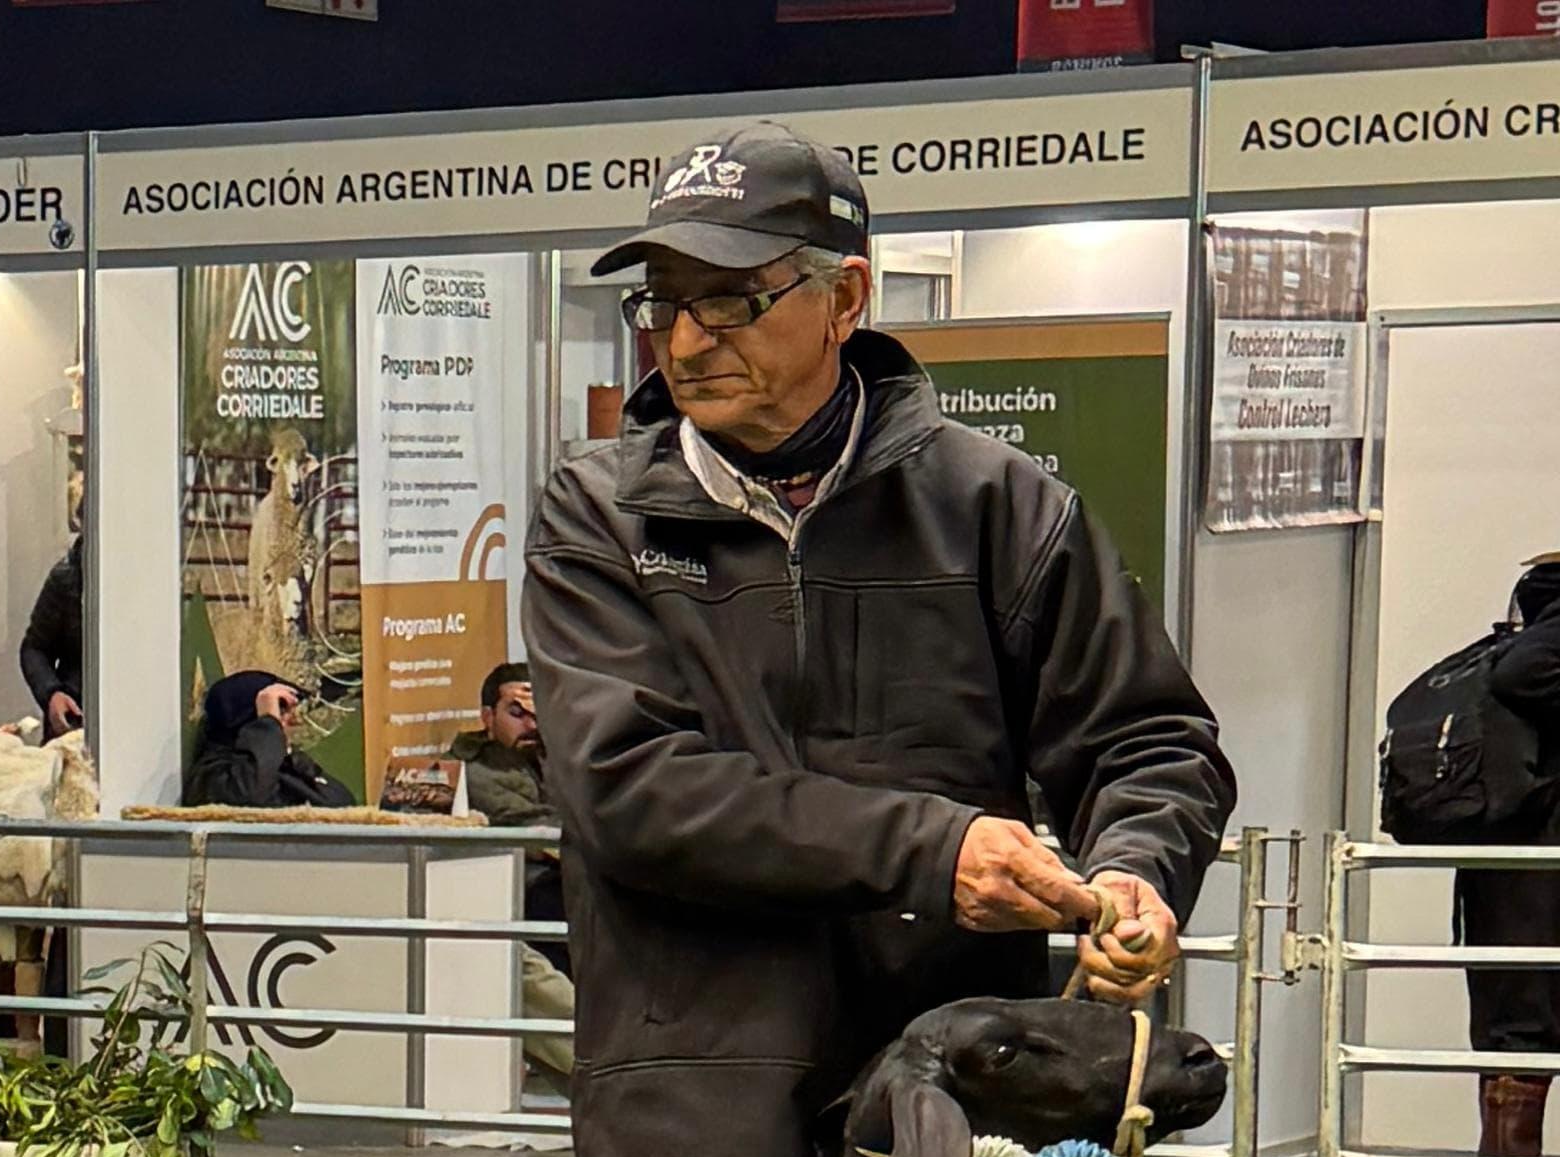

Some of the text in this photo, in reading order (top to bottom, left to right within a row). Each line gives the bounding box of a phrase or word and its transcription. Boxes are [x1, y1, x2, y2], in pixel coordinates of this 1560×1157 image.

[1241, 100, 1560, 152] ASOCIACIÓN CR
[123, 168, 325, 215] ASOCIACIÓN
[338, 165, 534, 203] ARGENTINA
[546, 161, 592, 192] DE
[603, 157, 661, 190] CRI
[891, 127, 1146, 174] CORRIEDALE
[229, 260, 312, 342] AC
[377, 264, 421, 316] AC
[423, 279, 486, 299] CRIADORES
[423, 299, 491, 319] CORRIEDALE
[221, 365, 320, 390] CRIADORES
[381, 354, 440, 380] Programa
[217, 394, 324, 419] CORRIEDALE
[1238, 398, 1332, 429] Control Lechero
[976, 424, 1025, 443] aza
[383, 613, 466, 640] Programa AC
